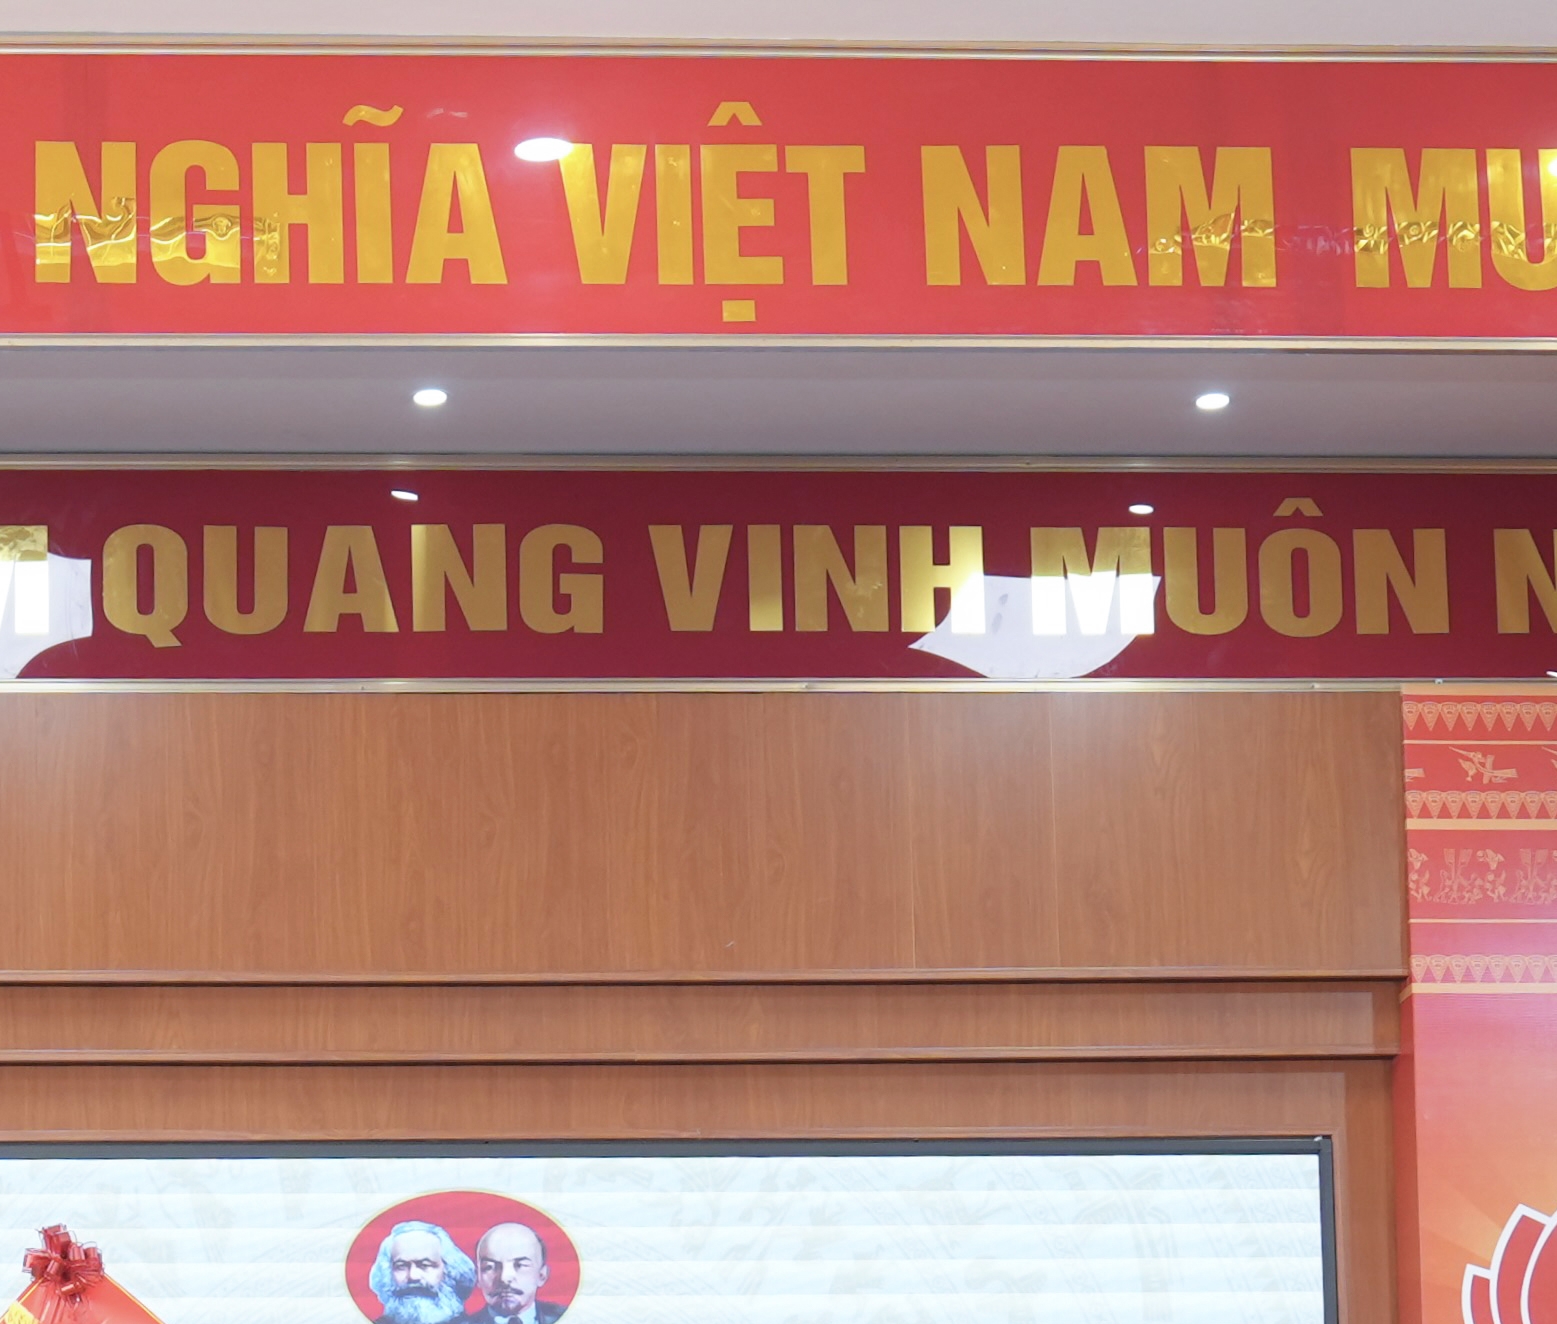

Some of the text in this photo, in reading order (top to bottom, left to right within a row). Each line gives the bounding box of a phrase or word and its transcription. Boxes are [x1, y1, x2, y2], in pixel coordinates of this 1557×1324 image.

[28, 100, 509, 290] NGHĨA
[553, 100, 869, 325] VIỆT
[922, 140, 1281, 290] NAM
[100, 520, 604, 640] QUANG
[648, 520, 988, 640] VINH
[1034, 495, 1454, 640] MUÔN
